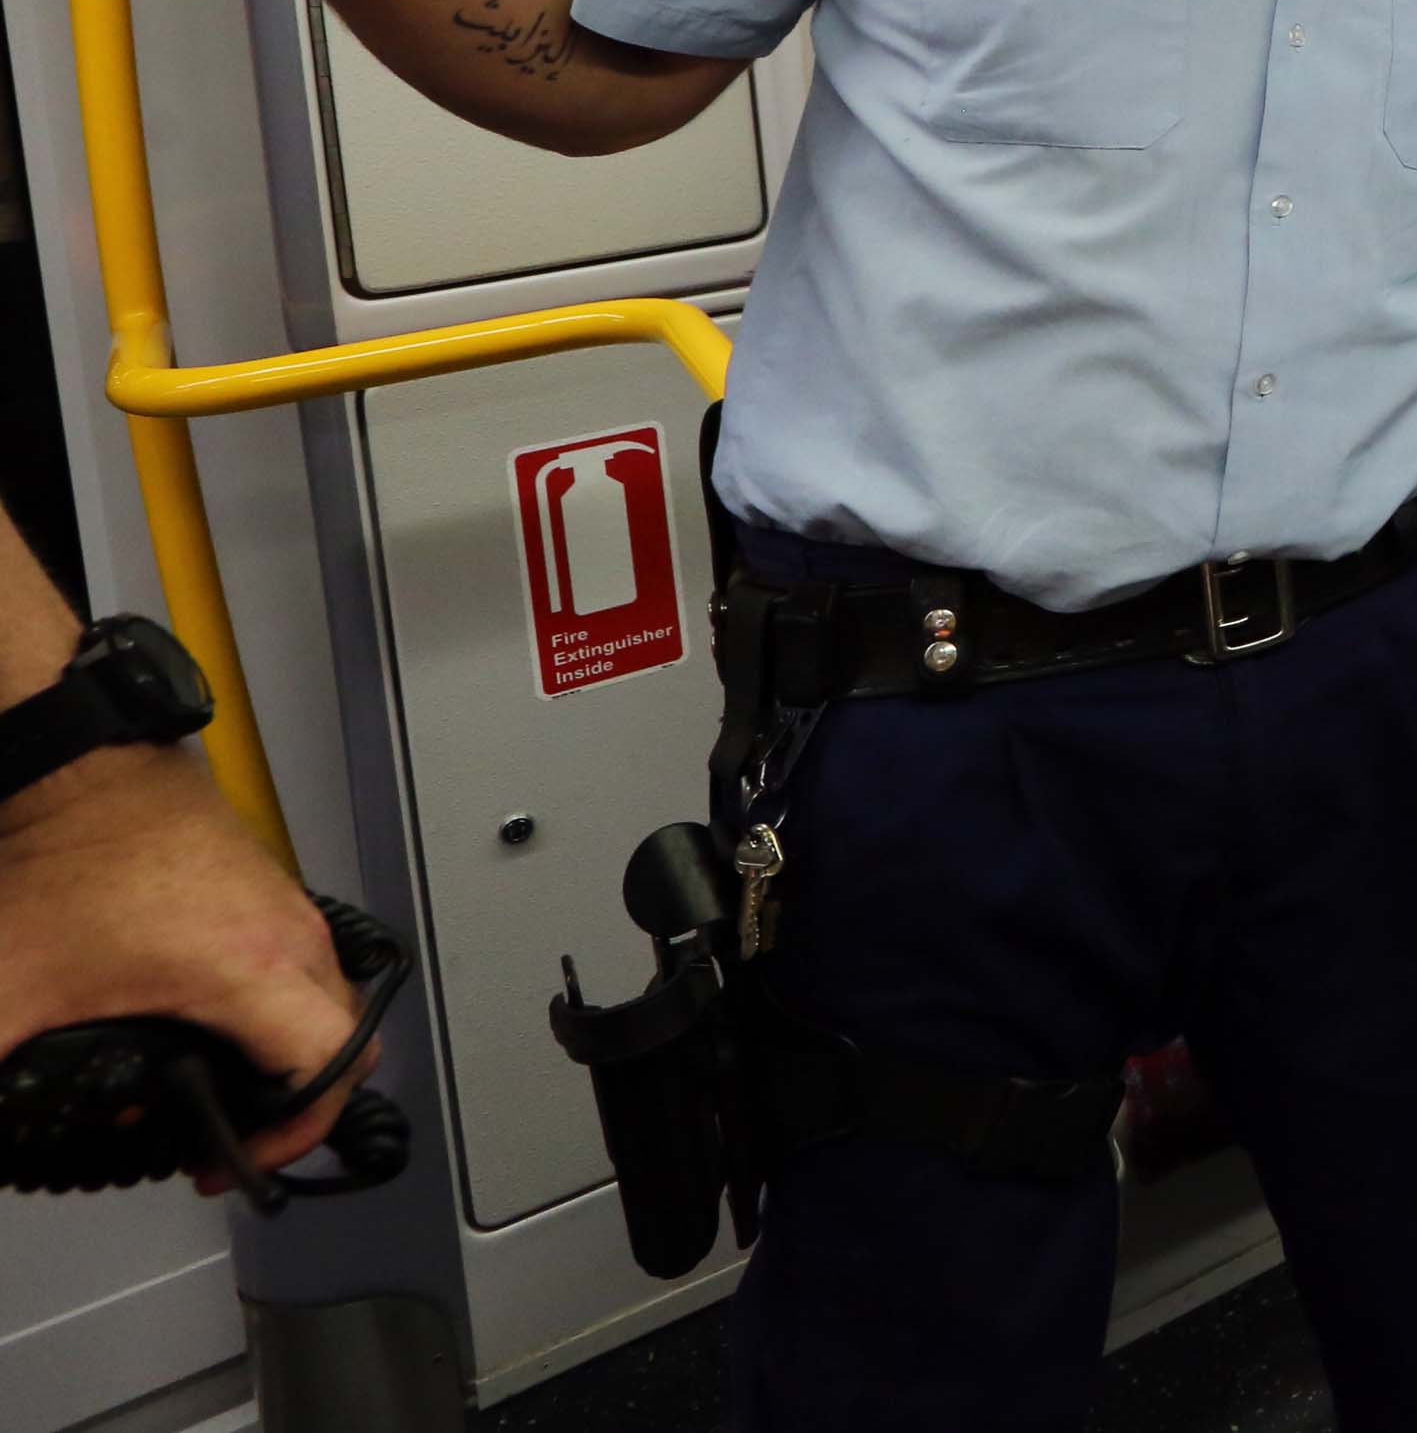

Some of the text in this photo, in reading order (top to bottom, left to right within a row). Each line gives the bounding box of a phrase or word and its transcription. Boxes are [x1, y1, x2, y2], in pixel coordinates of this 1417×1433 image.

[551, 628, 589, 648] Fire
[553, 625, 674, 667] Extinguisher
[555, 660, 614, 685] Inside
